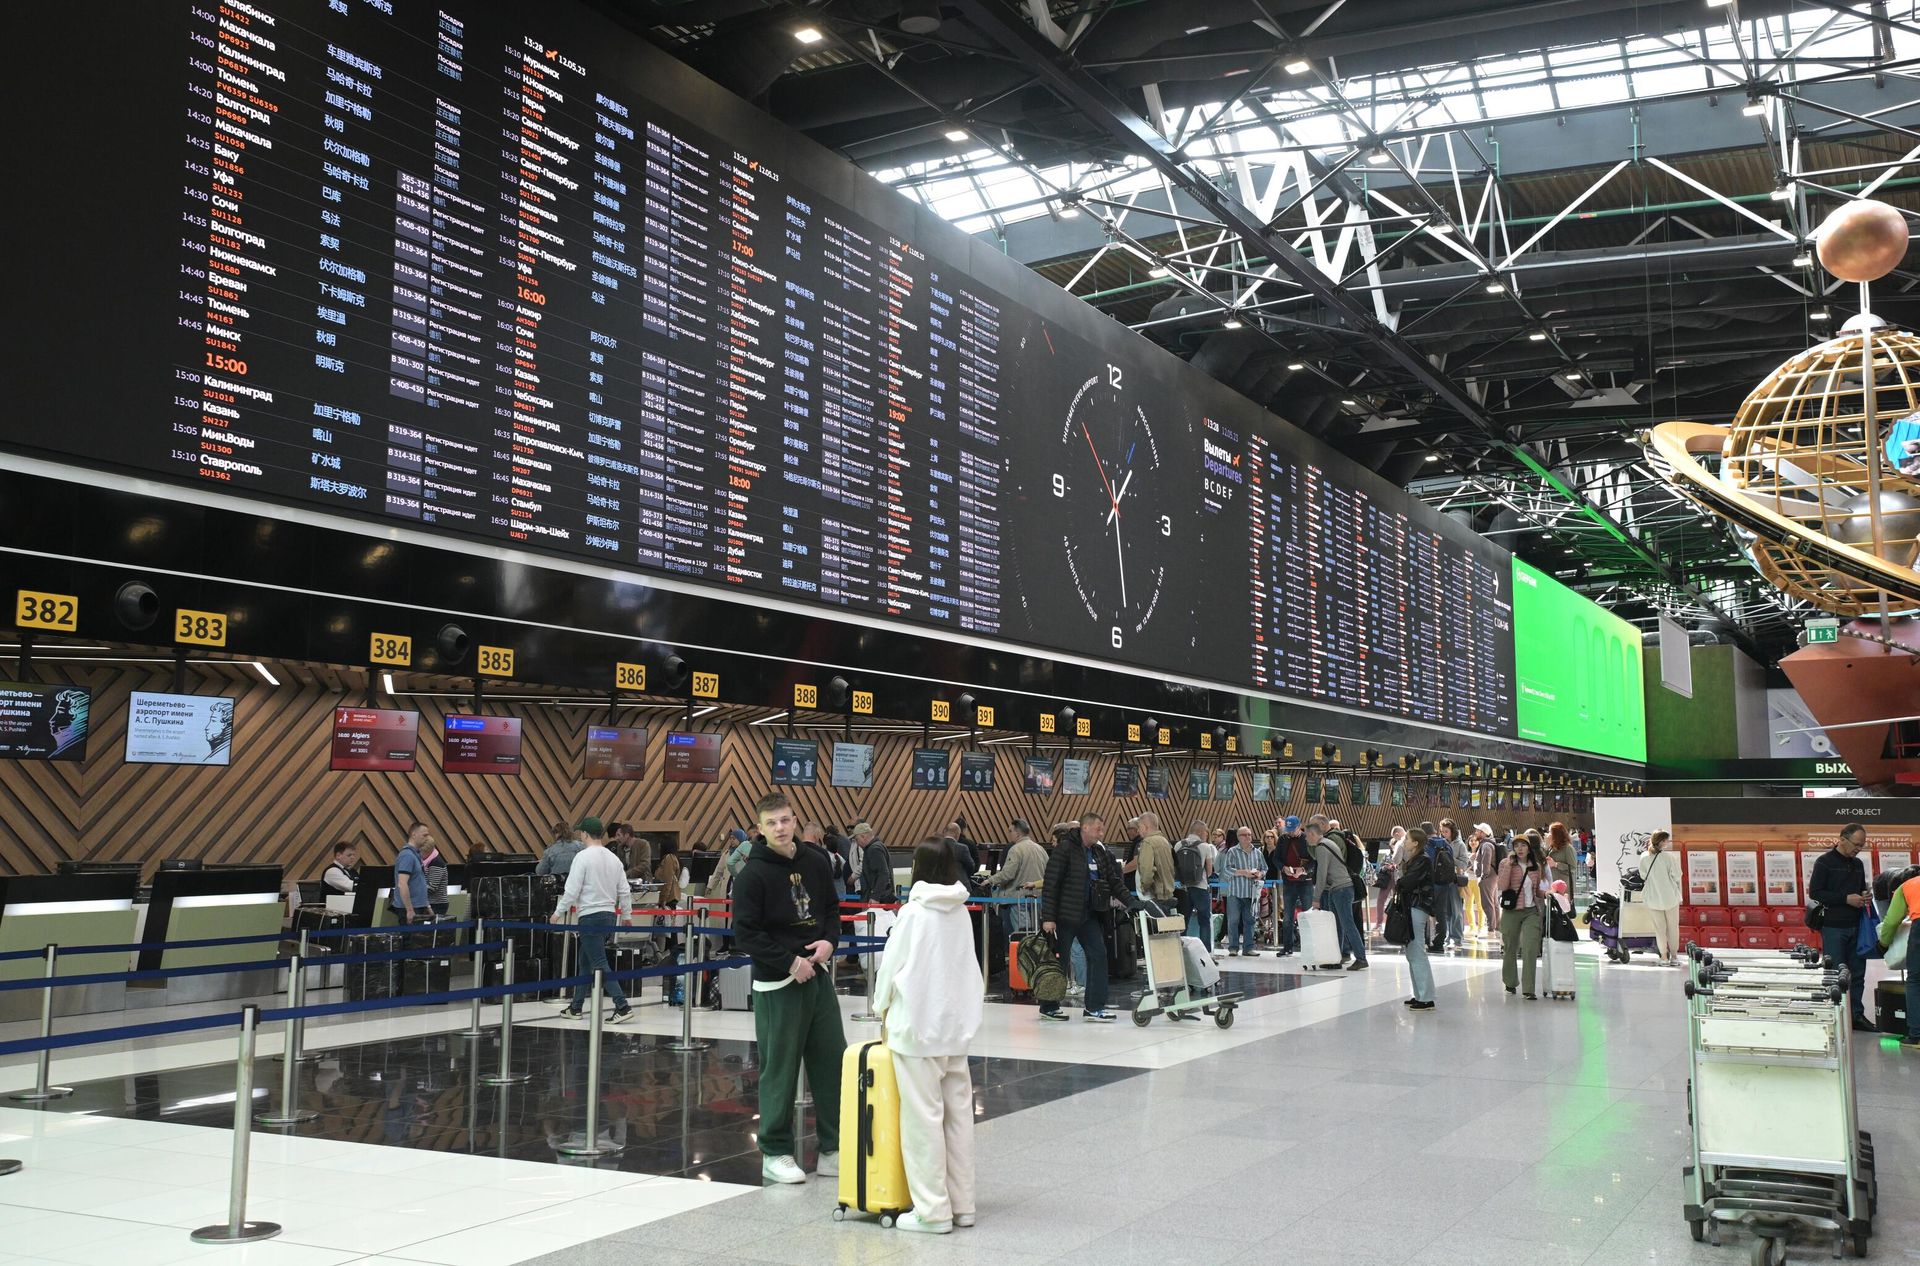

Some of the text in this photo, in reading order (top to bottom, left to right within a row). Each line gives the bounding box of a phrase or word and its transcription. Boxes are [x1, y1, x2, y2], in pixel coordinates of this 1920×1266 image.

[219, 5, 250, 24] SU1422
[224, 0, 275, 26] елябинск
[440, 10, 463, 28] Посадка
[192, 6, 275, 51] 14:00 Махачкала
[439, 32, 463, 49] Посадка
[219, 42, 285, 82] Калининград
[524, 36, 586, 76] 13:28 12.05.23
[218, 67, 258, 93] Тюмень
[189, 83, 270, 125] 14:20 Волгоград
[216, 81, 279, 113] FV6359 SU6359
[522, 95, 546, 113] Пермь
[214, 132, 245, 150] SU1058
[216, 118, 272, 149] Махачкала
[522, 116, 580, 150] Санкт-Петербург
[214, 144, 239, 162] Баку
[213, 157, 245, 175] SU1856
[213, 168, 234, 185] Уфа
[402, 173, 429, 190] 365-373
[184, 186, 238, 212] 14:30 Сочи
[401, 184, 429, 200] 431-436
[434, 187, 470, 207] Регистрация
[211, 208, 242, 225] SU1128
[210, 234, 241, 250] SU1182
[211, 220, 265, 248] Волгоград
[182, 238, 276, 276] 14:40 Нижнекамск
[732, 240, 753, 257] 17:00
[209, 260, 240, 276] SU1680
[518, 262, 532, 274] Уфа
[209, 272, 247, 292] Ереван
[517, 286, 546, 305] 16:00
[207, 297, 249, 318] Тюмень
[179, 317, 241, 342] 14:45 Минск
[516, 326, 534, 339] Сочи
[206, 352, 248, 375] 15:00
[515, 368, 540, 383] Казань
[1083, 376, 1098, 392] AIRPORT
[1107, 364, 1122, 390] 12
[203, 389, 235, 403] SU1018
[204, 375, 272, 402] Калининград
[514, 390, 553, 408] Чебоксары
[203, 401, 240, 418] Казань
[174, 423, 254, 448] 15:05 Мин.Воды
[1208, 419, 1238, 442] 13:28 12.05.23
[201, 442, 233, 455] SU1300
[1204, 438, 1231, 463] Вылеты
[172, 450, 262, 475] 15:10 Ставрополь
[1205, 455, 1242, 484] Departures
[199, 468, 231, 481] SU1362
[729, 475, 750, 490] 18:00
[512, 476, 551, 492] Махачкала
[1052, 474, 1064, 498] 9
[1205, 478, 1232, 500] B C D E F
[492, 494, 542, 512] 16:45 Стамбул
[492, 516, 569, 539] 16:50 Шарм-эль-Шейх
[1161, 515, 1171, 536] 3
[22, 597, 73, 625] 382
[180, 615, 222, 640] 383
[1112, 627, 1122, 648] 6
[374, 638, 408, 660] 384
[482, 650, 511, 672] 385
[619, 667, 643, 685] 386
[695, 676, 716, 693] 387
[137, 699, 185, 708] Шереметьево
[797, 688, 815, 704] 388
[854, 695, 871, 710] 389
[934, 704, 948, 718] 390
[979, 709, 991, 722] 391
[152, 718, 184, 726] Пушкина
[1041, 717, 1052, 729] 392
[1078, 721, 1089, 734] 393
[1129, 728, 1139, 738] 394
[1160, 732, 1169, 742] 395
